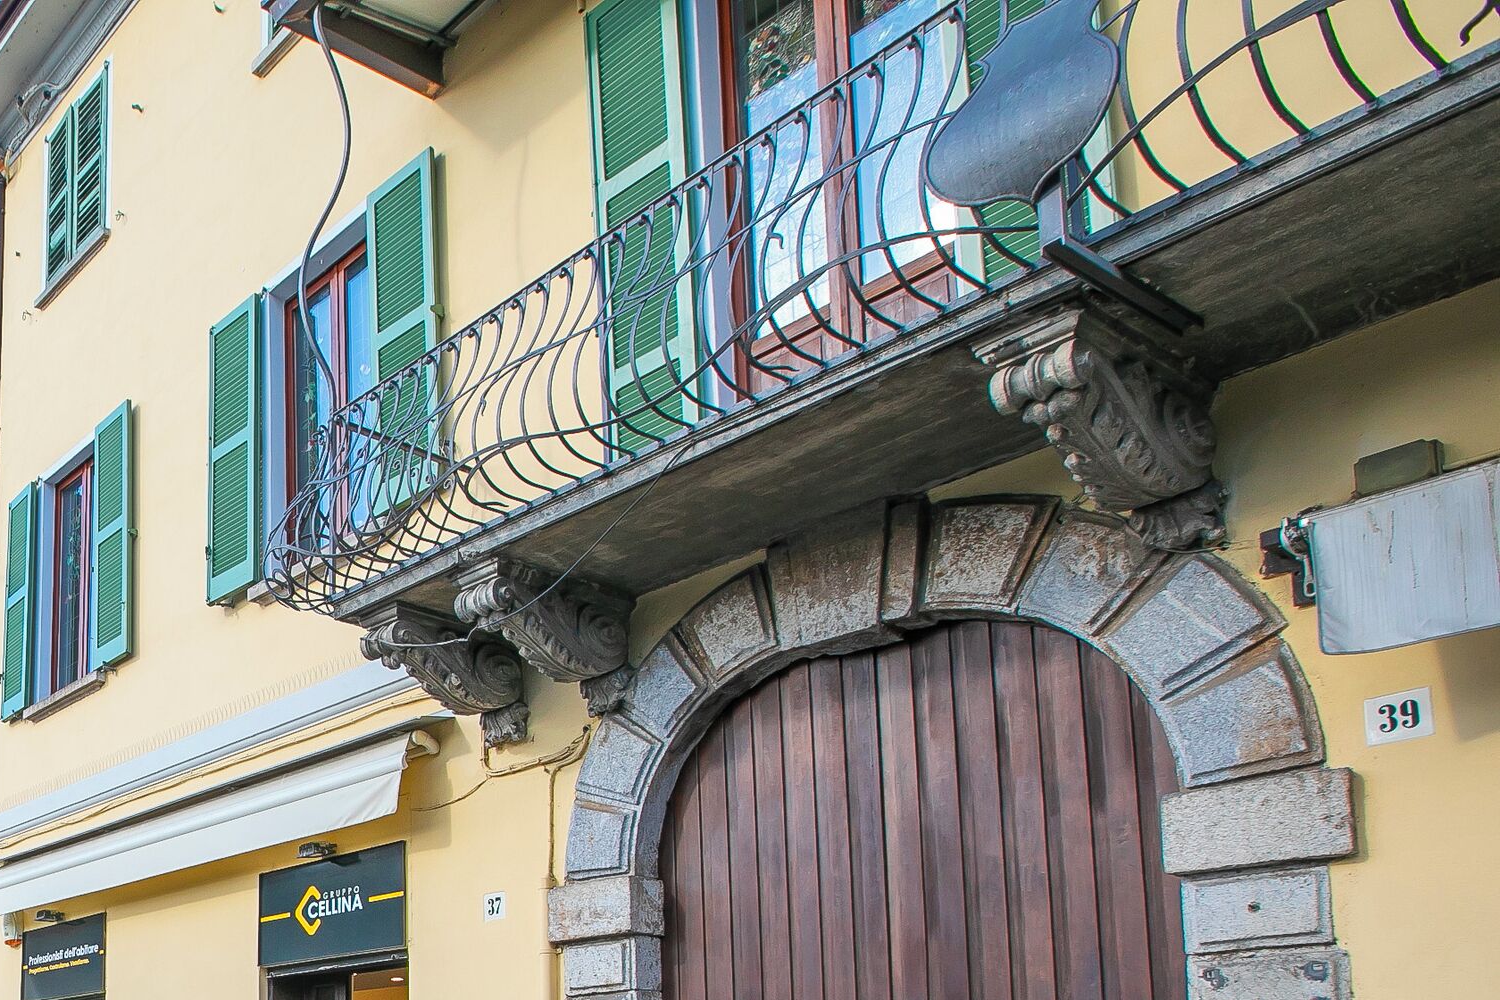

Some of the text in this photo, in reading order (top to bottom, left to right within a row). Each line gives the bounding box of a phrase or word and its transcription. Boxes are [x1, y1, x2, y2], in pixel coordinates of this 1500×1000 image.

[1377, 699, 1420, 734] 39
[322, 885, 360, 900] GRUPPO
[307, 893, 363, 919] CELLINA
[487, 896, 501, 916] 37
[28, 944, 99, 966] Professionisti dell'abitare
